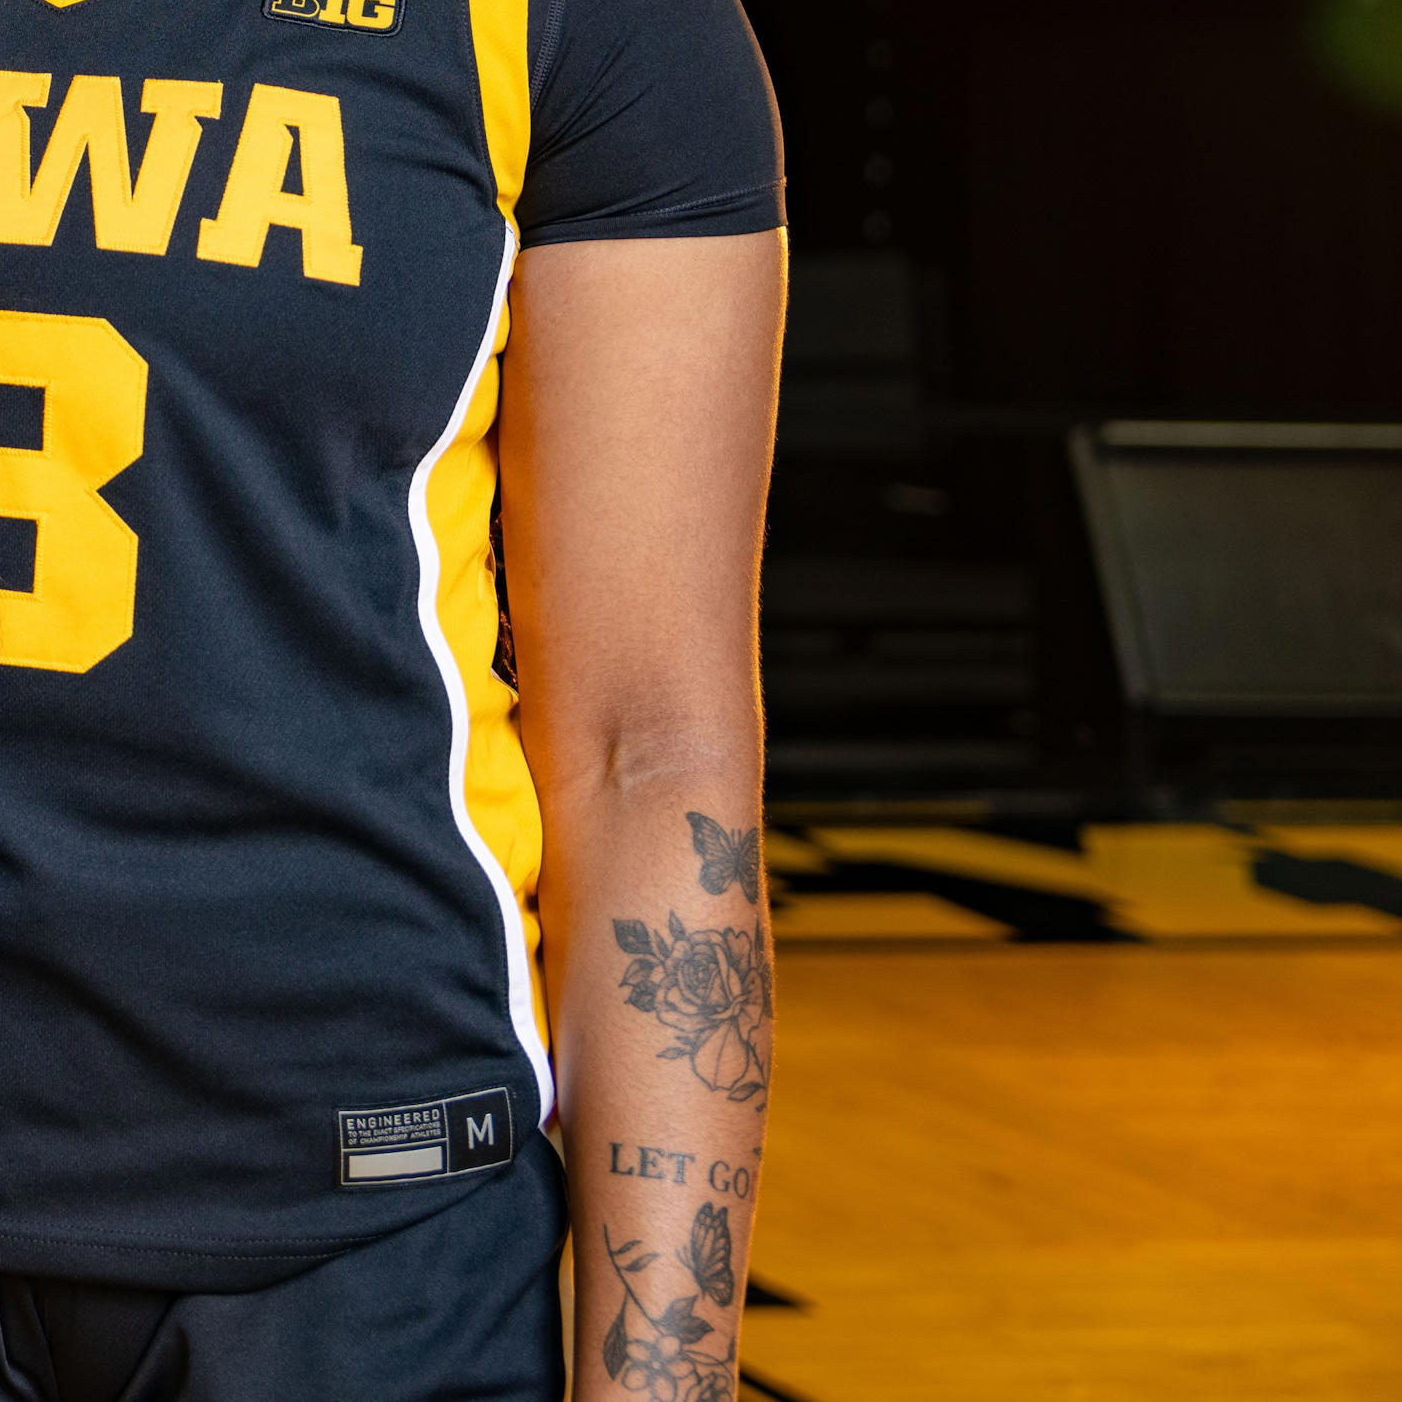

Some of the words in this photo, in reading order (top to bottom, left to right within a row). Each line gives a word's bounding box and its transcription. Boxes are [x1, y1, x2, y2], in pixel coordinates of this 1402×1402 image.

[346, 1108, 440, 1130] ENGINEERED
[373, 1127, 393, 1136] EXACT
[394, 1121, 441, 1133] SPECIFICATIONS
[360, 1133, 408, 1145] CHAMPIONSHIP
[411, 1128, 441, 1140] ATHLETES
[466, 1113, 494, 1149] M
[609, 1142, 695, 1184] LET
